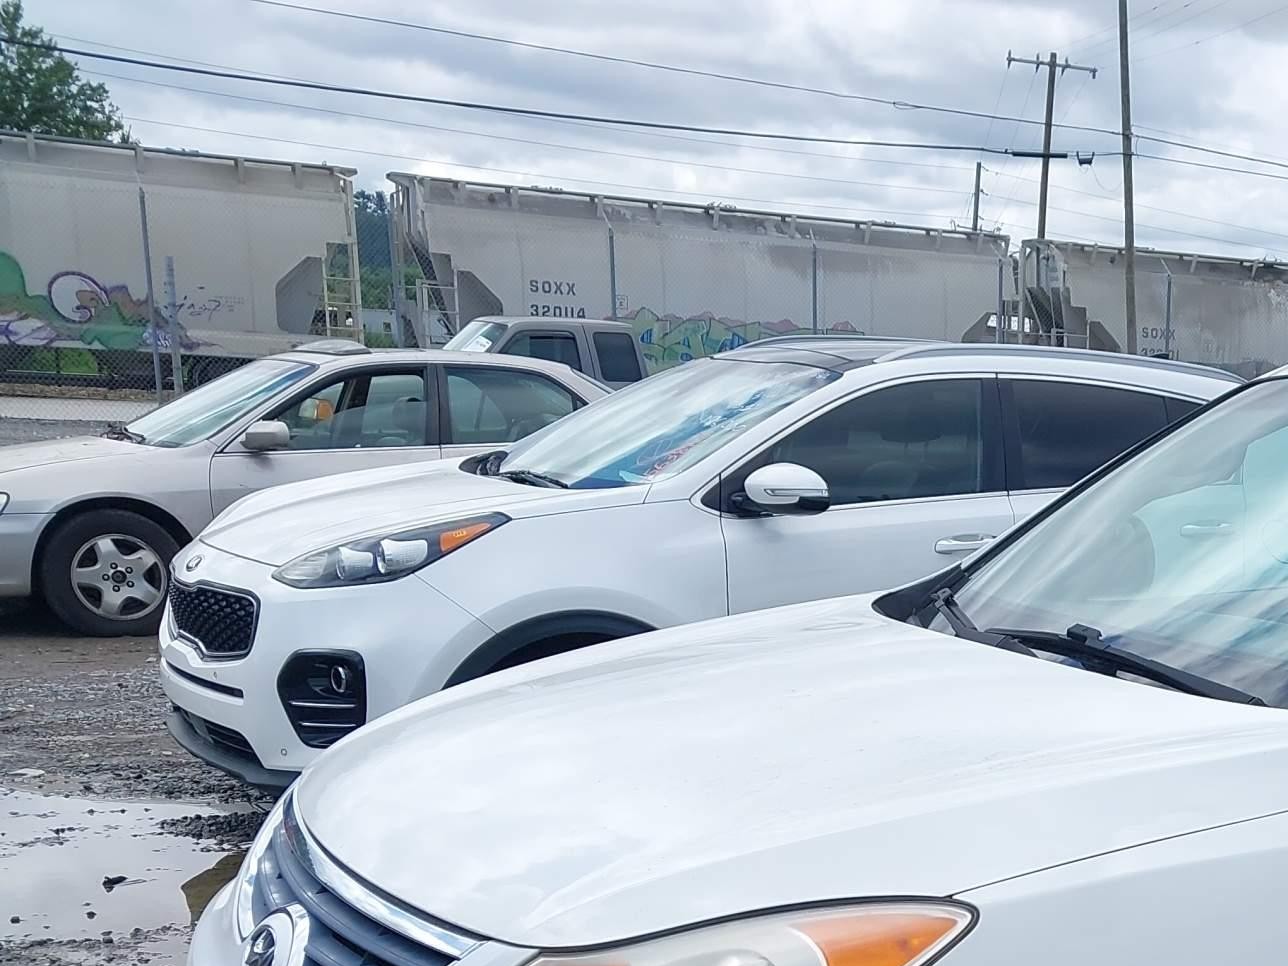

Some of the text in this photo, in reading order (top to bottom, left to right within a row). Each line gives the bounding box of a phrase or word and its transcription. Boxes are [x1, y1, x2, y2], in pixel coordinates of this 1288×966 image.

[529, 280, 576, 296] SOXX
[530, 304, 586, 319] 320114
[1142, 327, 1176, 341] SOXX
